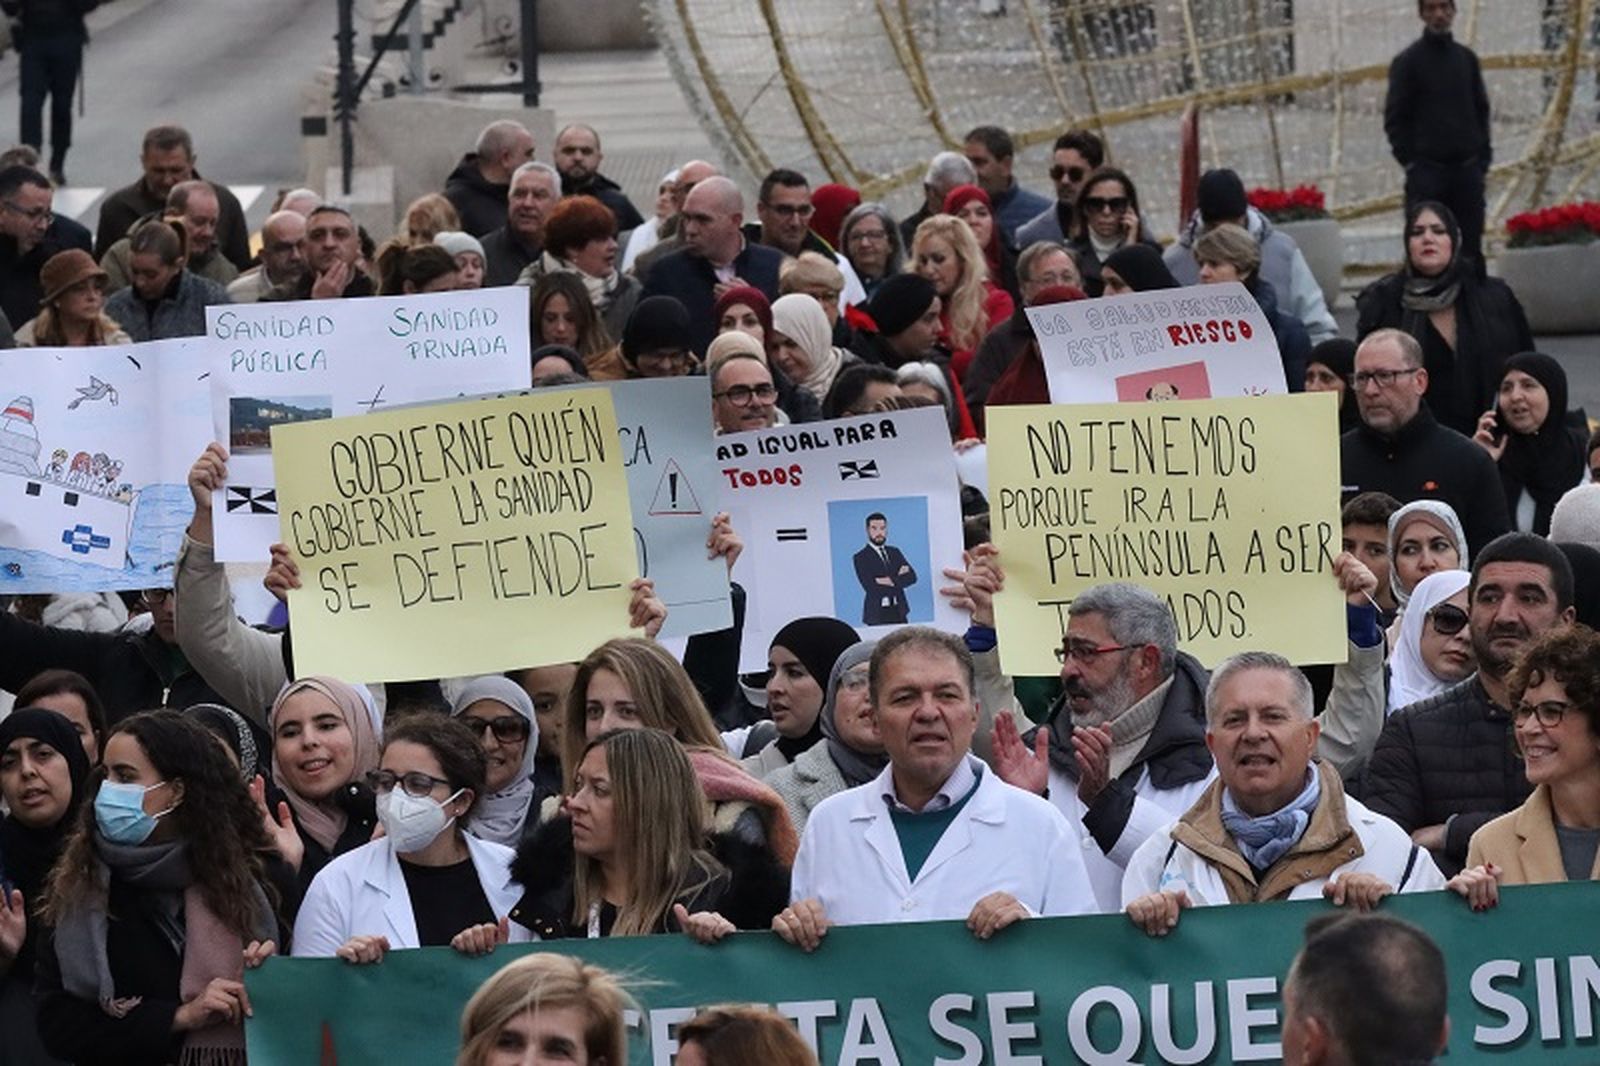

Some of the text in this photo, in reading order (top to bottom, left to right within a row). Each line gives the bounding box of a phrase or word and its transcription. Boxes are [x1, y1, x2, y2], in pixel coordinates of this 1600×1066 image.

[215, 311, 334, 340] SANIDAD
[389, 306, 498, 337] SANIDAD
[1033, 312, 1072, 337] LA
[1084, 303, 1171, 331] SALUD
[406, 335, 507, 360] PRIVADA
[1130, 327, 1166, 357] EN
[330, 399, 606, 499] GOBIERNE QUIÉN
[758, 430, 829, 455] IGUAL
[834, 419, 898, 447] PARA
[1027, 415, 1256, 479] NO TENEMOS
[723, 464, 803, 489] TODOS
[291, 467, 593, 558] GOBIERNE LA SANIDAD
[1000, 487, 1097, 529] PORQUE
[319, 562, 370, 613] SE
[393, 522, 622, 608] DEFIENDE
[1045, 521, 1336, 585] PENÍNSULA A SER
[929, 990, 1043, 1066] SE
